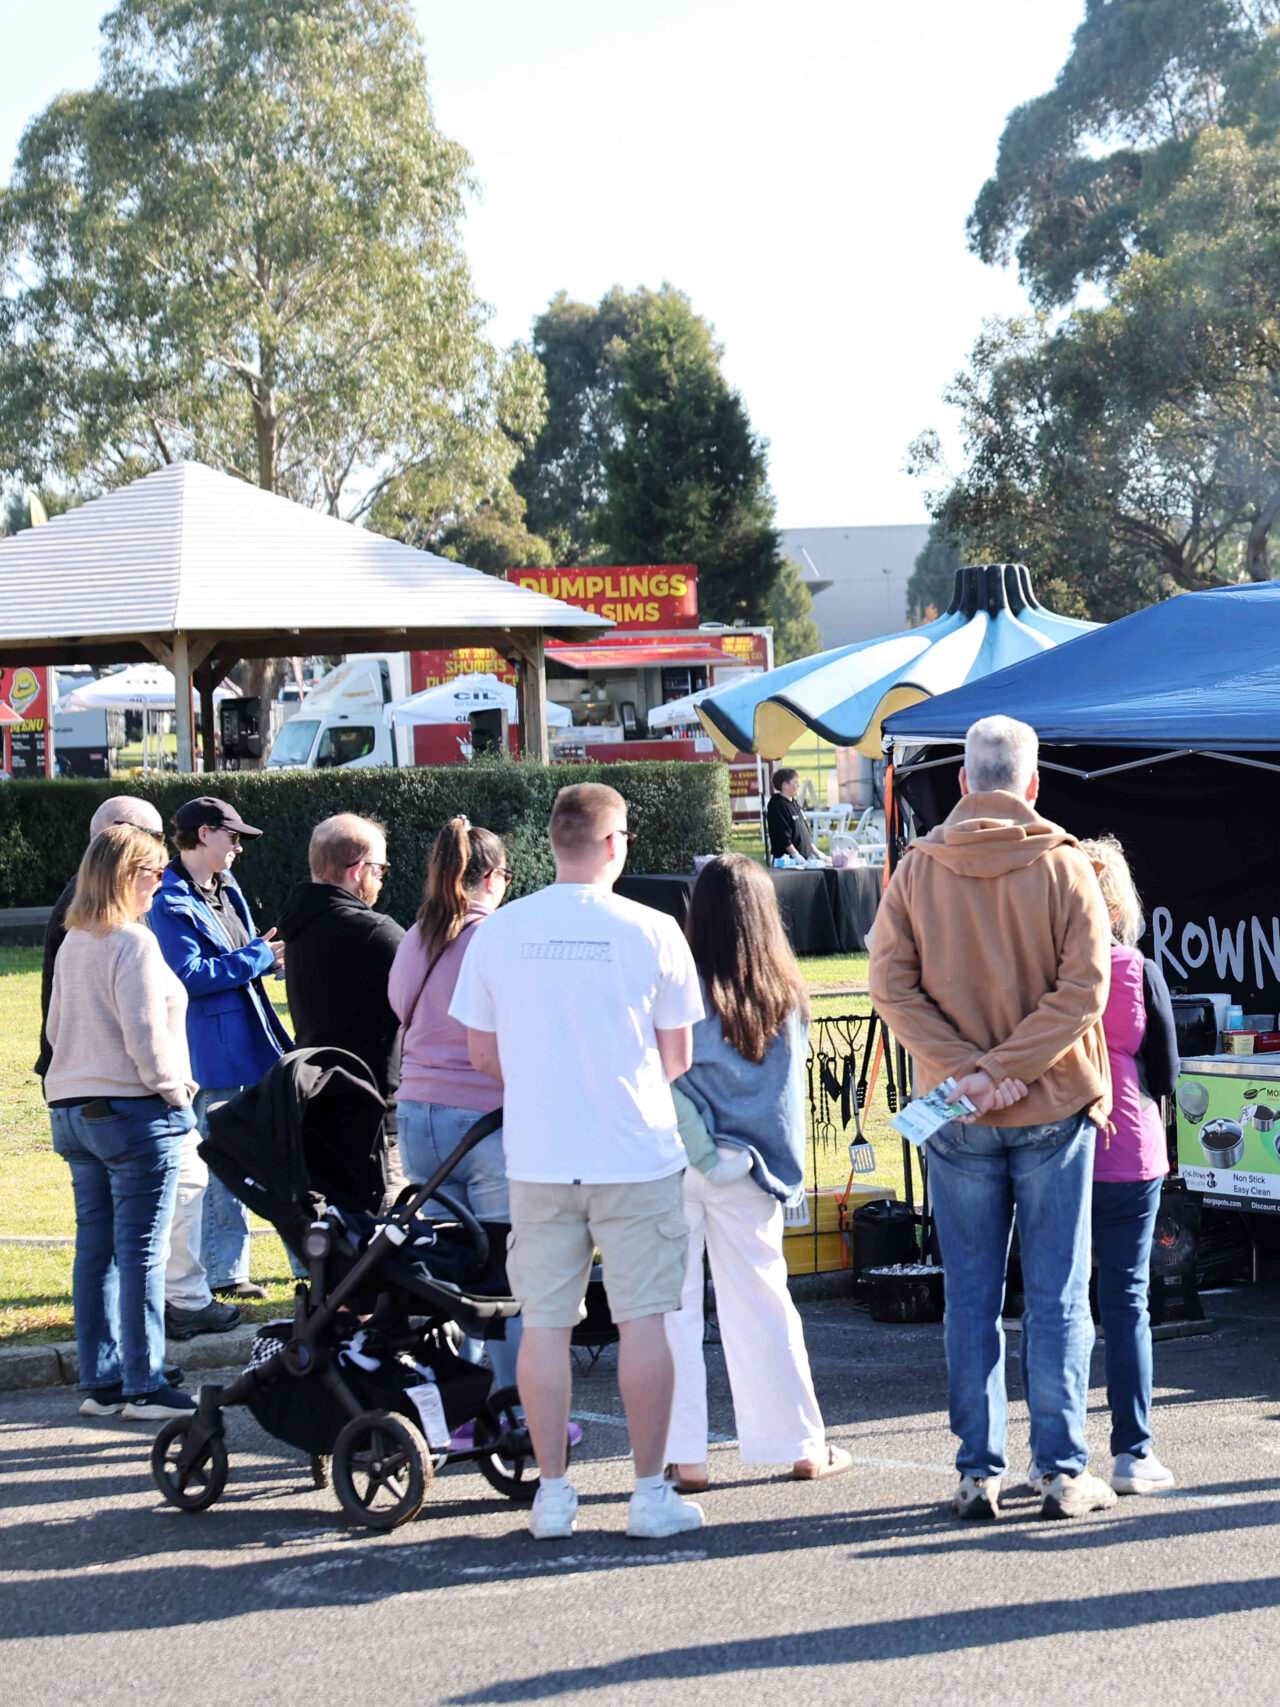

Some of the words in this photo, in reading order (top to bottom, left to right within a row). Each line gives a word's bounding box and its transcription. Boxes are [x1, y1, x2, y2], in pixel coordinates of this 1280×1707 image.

[600, 602, 660, 623] SIMS
[453, 692, 497, 700] CIL
[1233, 1174, 1246, 1183] Non
[1248, 1175, 1266, 1184] Stick
[1233, 1185, 1249, 1194] Easy
[1250, 1186, 1271, 1196] Clean
[1251, 1201, 1276, 1211] Discount
